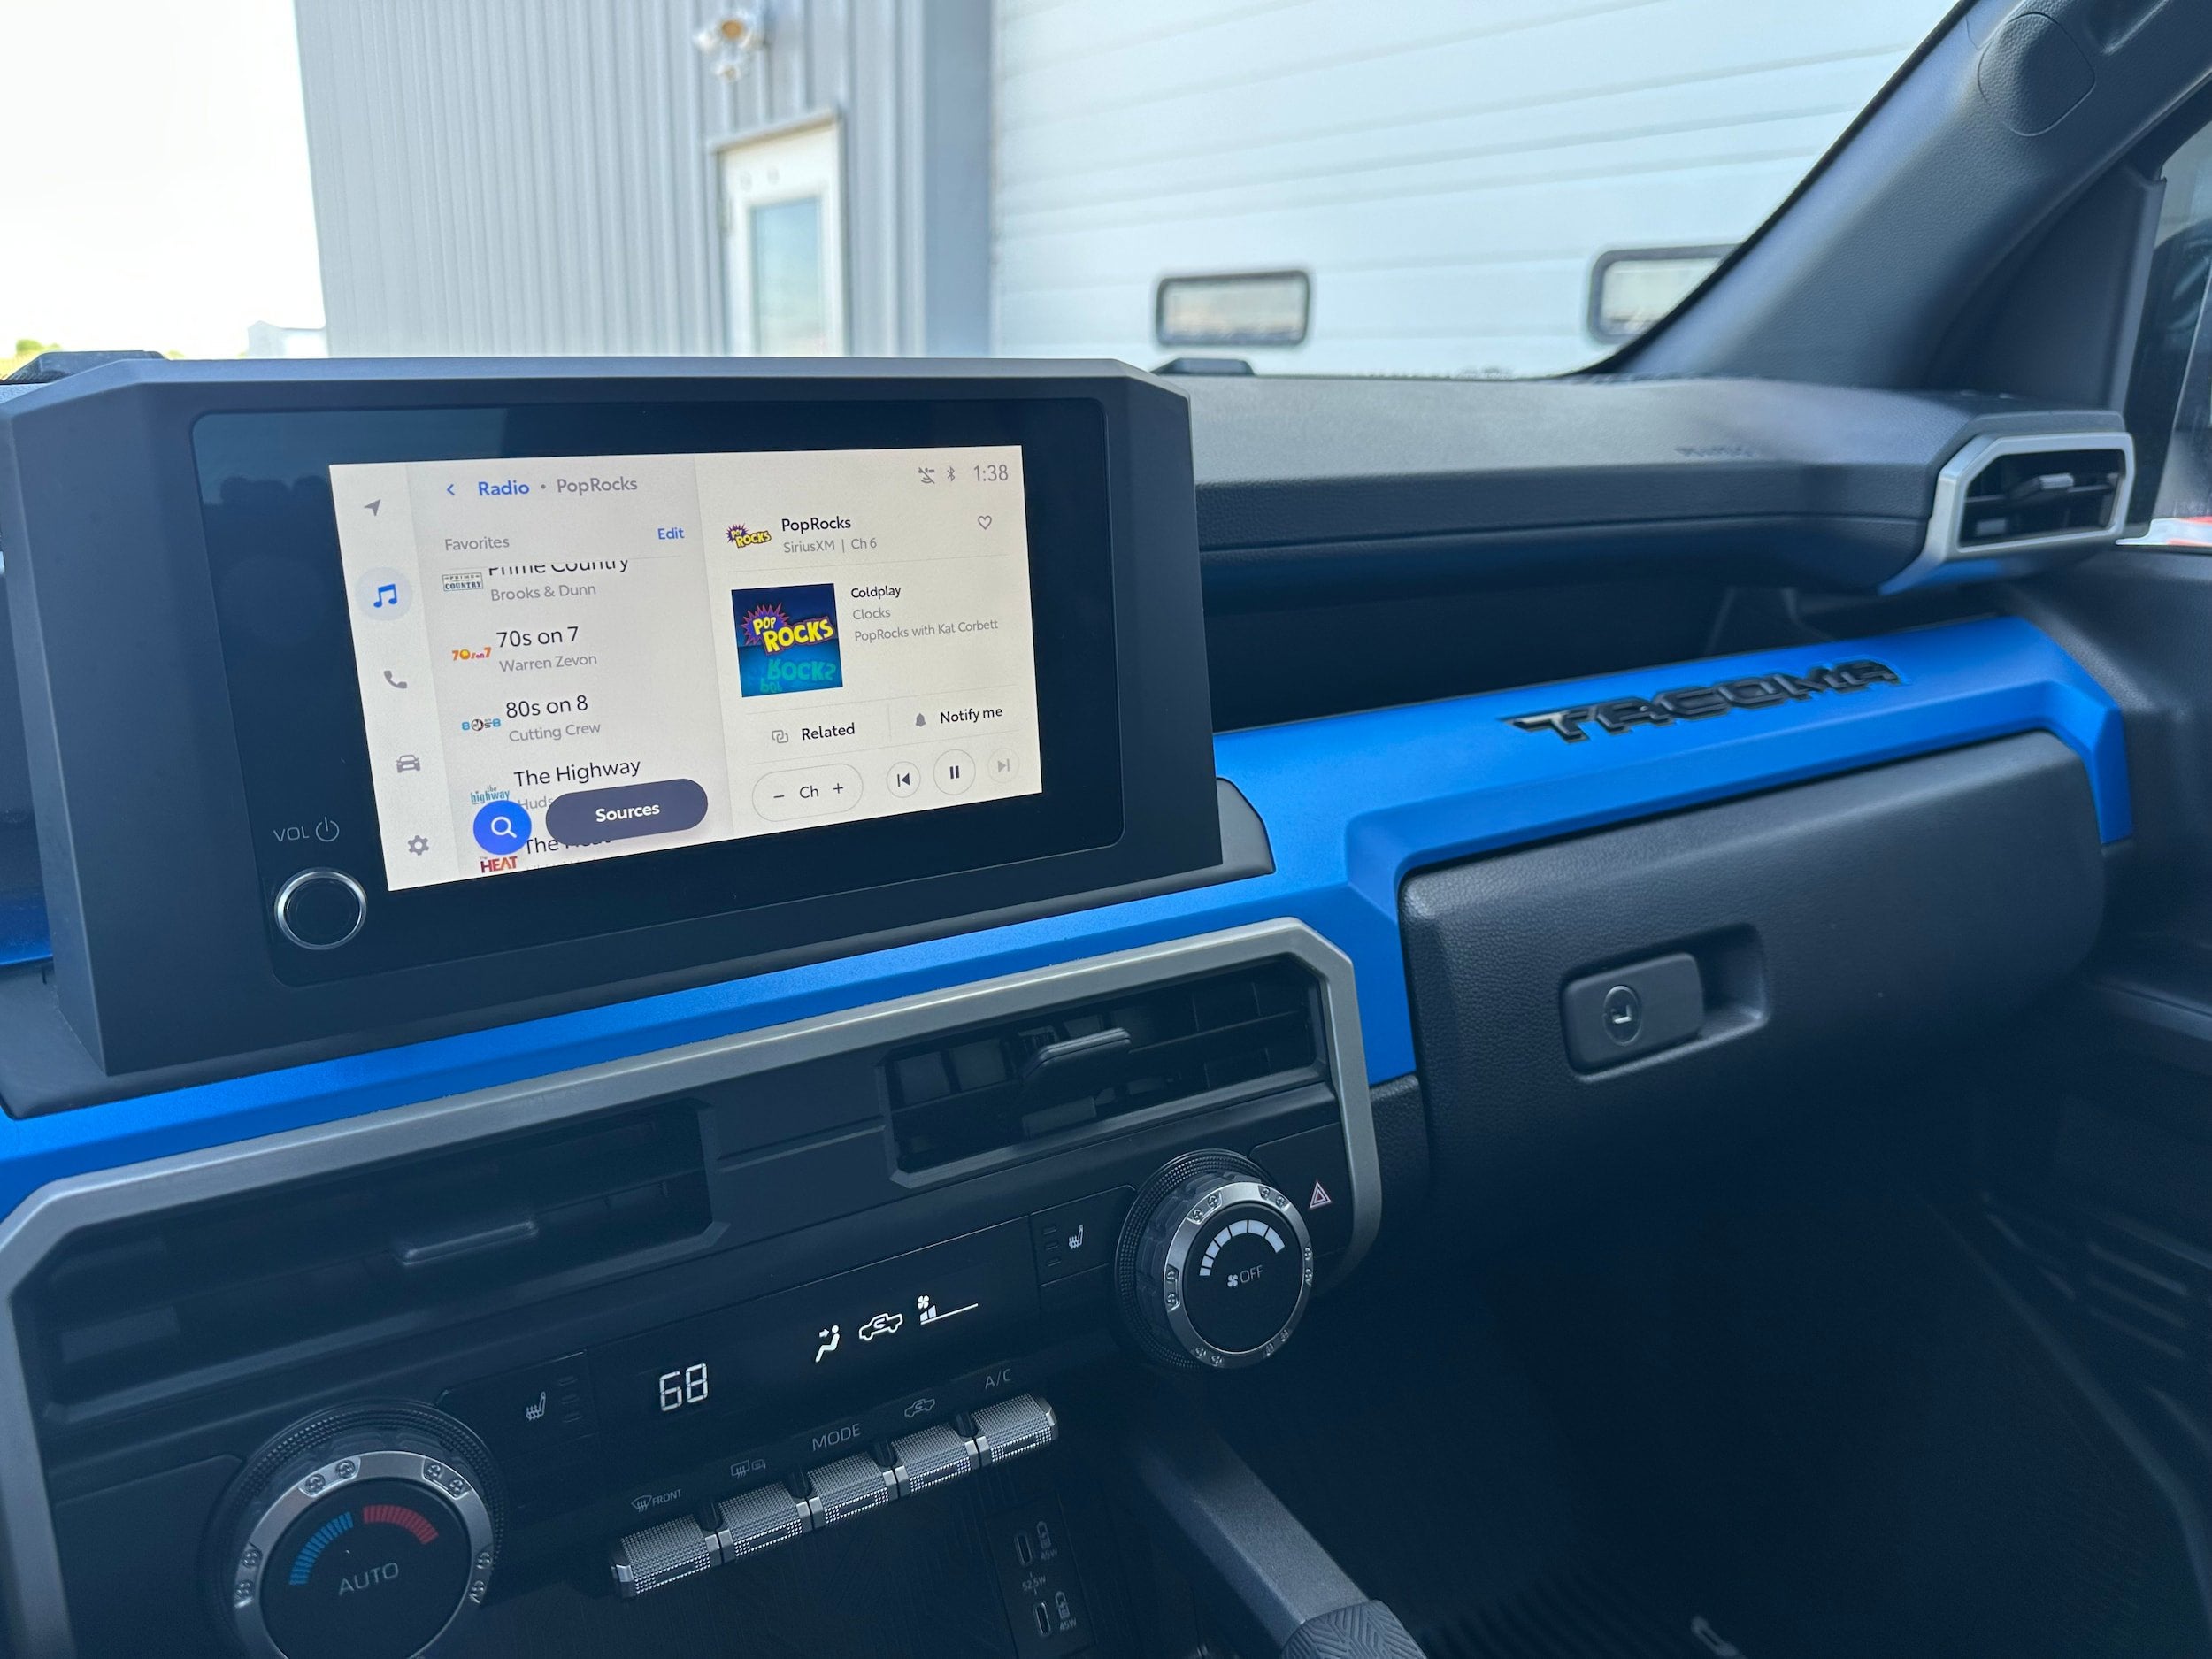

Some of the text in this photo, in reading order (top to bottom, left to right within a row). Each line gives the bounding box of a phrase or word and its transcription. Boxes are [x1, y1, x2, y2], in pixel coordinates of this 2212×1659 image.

[973, 464, 1009, 482] 1:38
[478, 476, 638, 496] Radio PopRocks
[657, 527, 685, 540] Edit
[781, 516, 852, 534] PopRocks
[445, 535, 510, 551] Favorites
[736, 531, 771, 548] ROCKS
[783, 537, 877, 554] SiriusXM Ch 6
[445, 580, 481, 589] COUNTRY
[491, 584, 596, 602] Brooks & Dunn
[851, 585, 902, 600] Coldplay
[852, 607, 891, 620] Clocks
[496, 626, 579, 648] 70s on 7
[753, 616, 833, 653] POP ROCKS
[855, 618, 999, 642] PopRocks with Kat Corbett
[499, 656, 597, 672] Warren Zevon
[506, 695, 588, 718] 80s on 8
[1502, 658, 1904, 743] TACOMA
[940, 707, 1003, 725] Notify me
[509, 724, 601, 742] Cutting Crew
[802, 723, 856, 741] Related
[514, 761, 641, 787] The Highway
[471, 790, 510, 803] highway
[799, 785, 819, 799] Ch
[595, 803, 660, 823] Sources
[273, 826, 310, 841] VOL
[526, 837, 559, 854] The
[480, 856, 518, 873] HEAT
[1240, 1264, 1263, 1283] OFF
[659, 1363, 708, 1412] 68
[985, 1369, 1012, 1389] A/C
[811, 1423, 862, 1451] MODE
[652, 1489, 681, 1506] FRONT
[339, 1562, 400, 1596] AUTO
